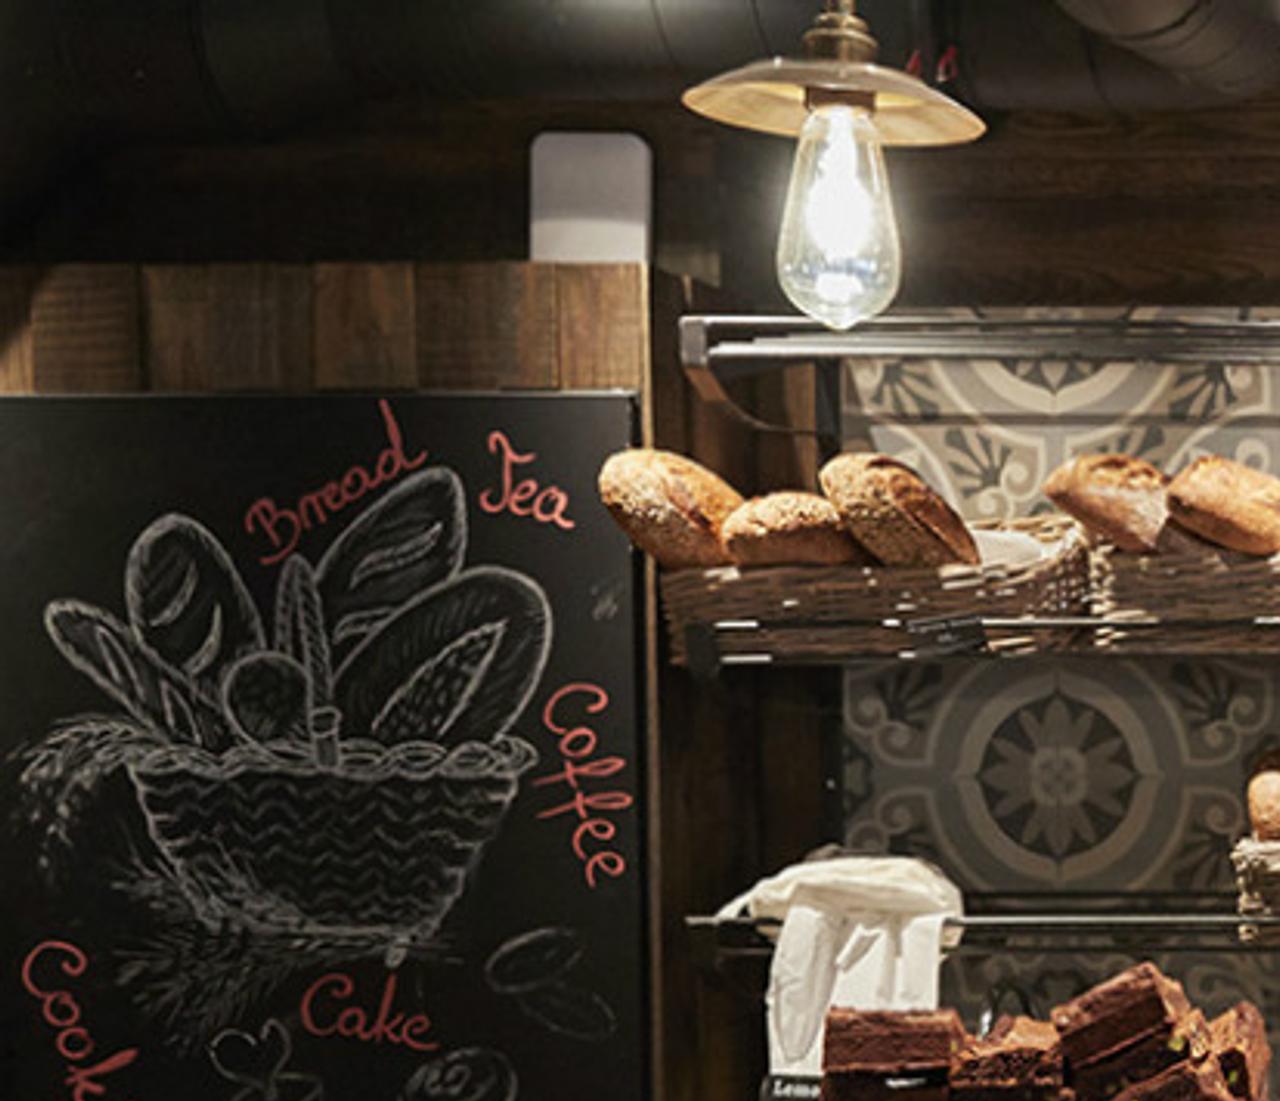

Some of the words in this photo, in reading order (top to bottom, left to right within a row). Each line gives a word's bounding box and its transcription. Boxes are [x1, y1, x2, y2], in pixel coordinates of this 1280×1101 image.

[245, 398, 428, 565] Bread
[480, 430, 575, 529] Tea
[532, 682, 633, 888] Coffee
[301, 972, 440, 1050] Cake
